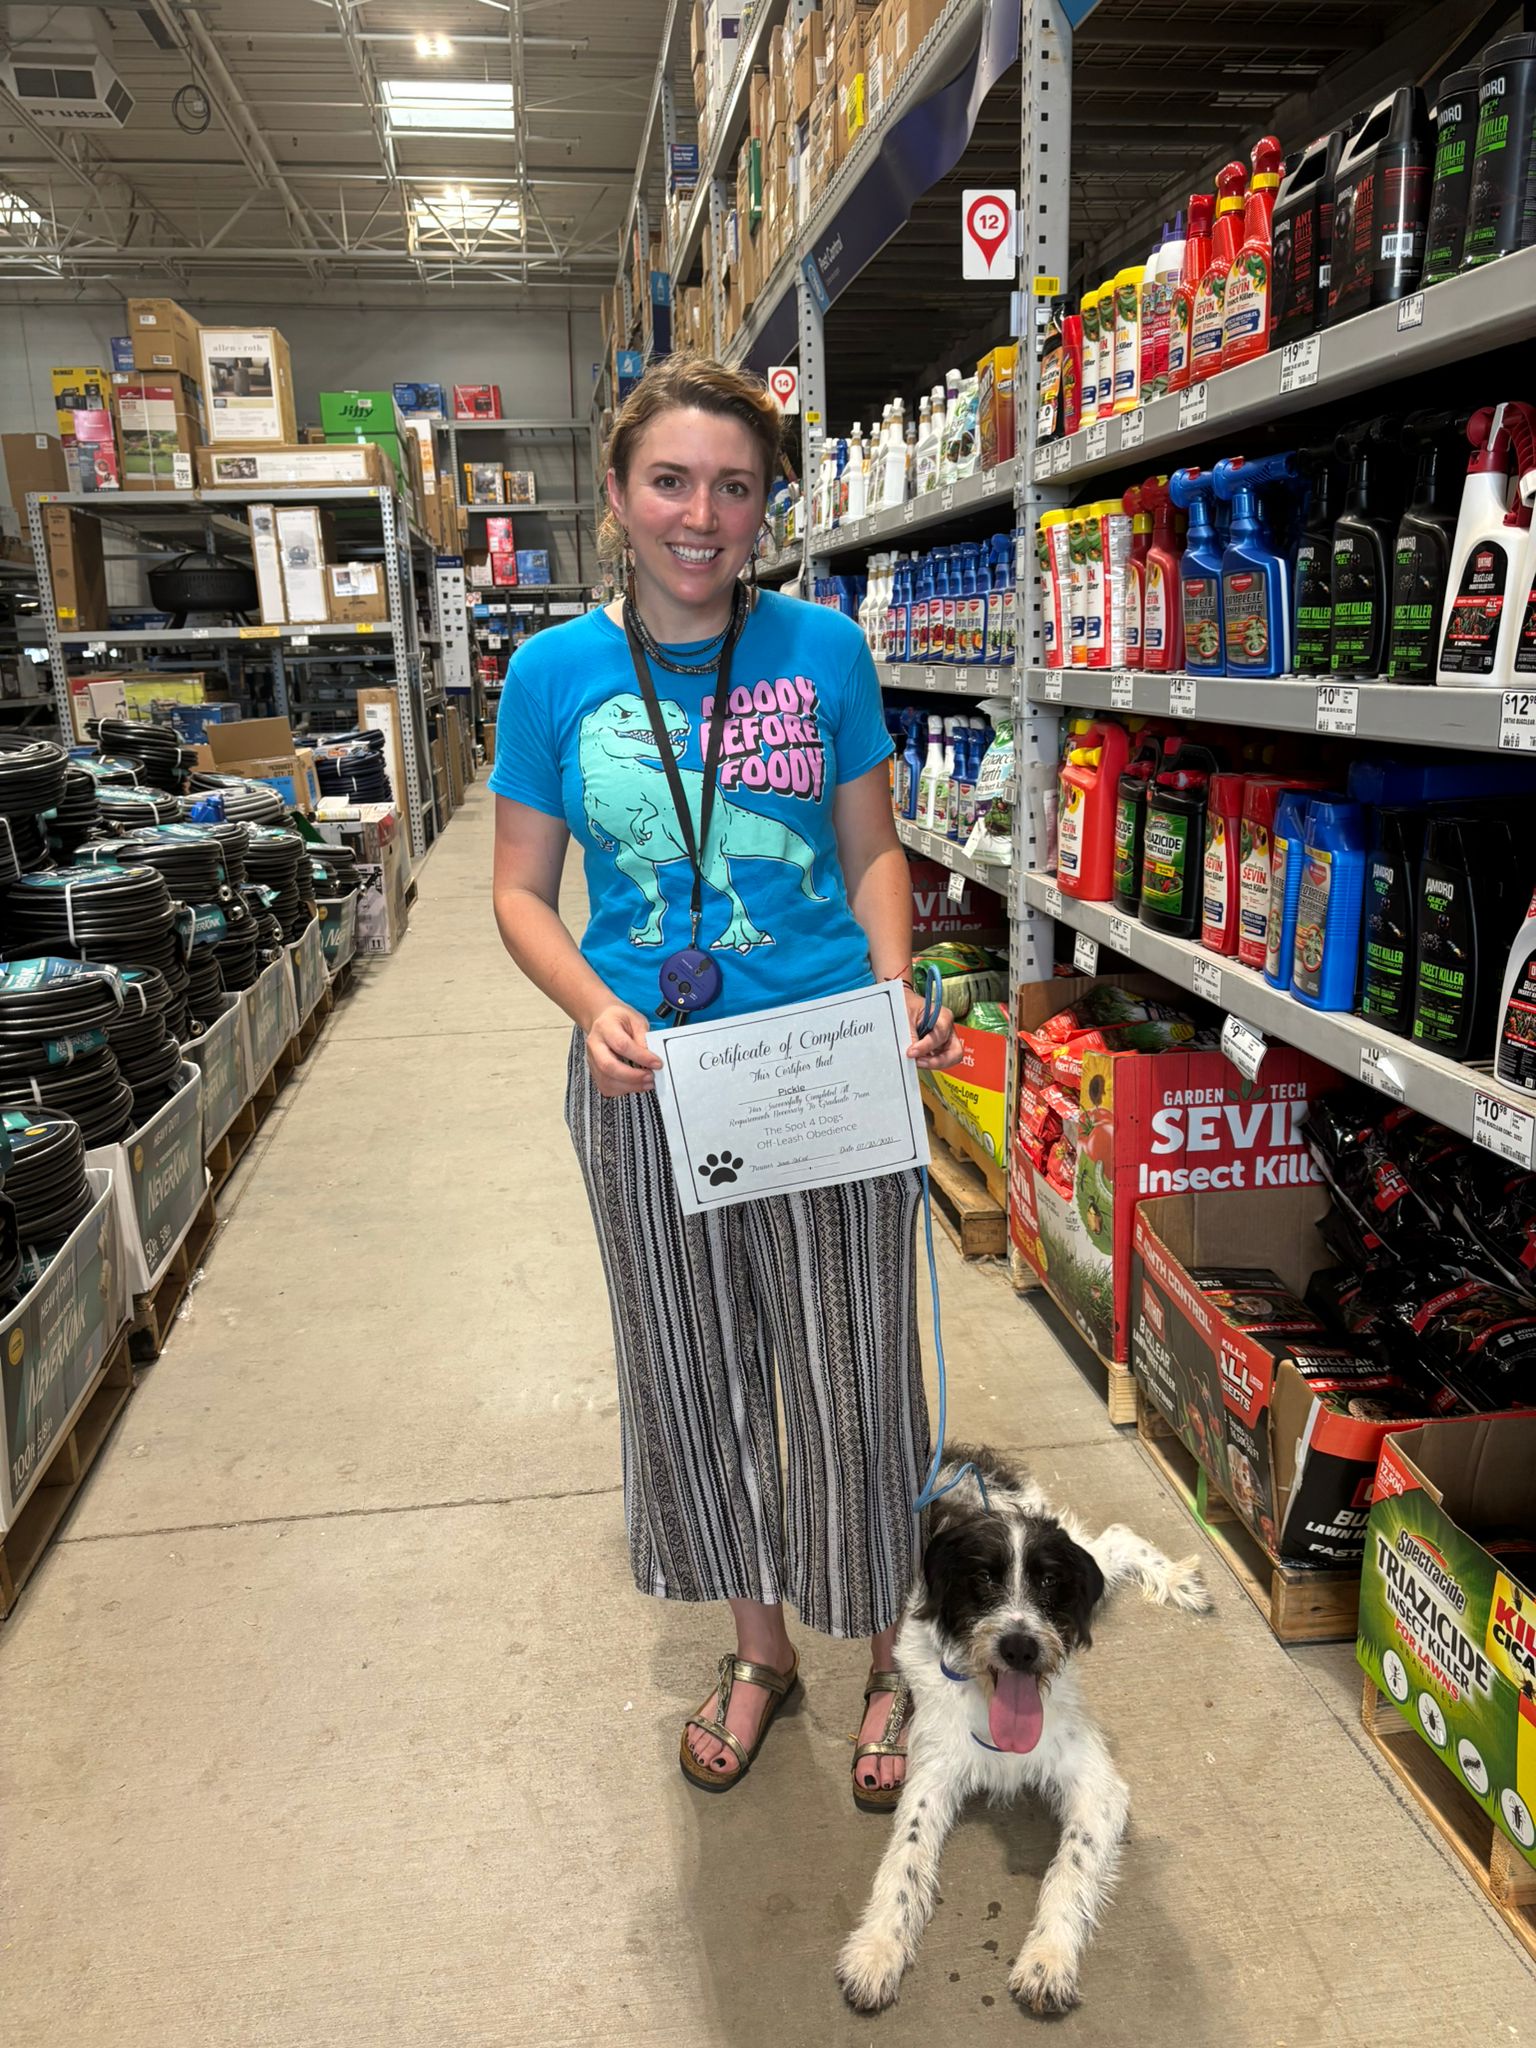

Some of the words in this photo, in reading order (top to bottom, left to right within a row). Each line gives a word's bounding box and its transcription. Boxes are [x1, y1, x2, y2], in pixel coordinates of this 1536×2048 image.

[1479, 77, 1505, 98] MDRO
[1437, 104, 1462, 126] MDRO
[1357, 176, 1374, 194] ANT
[979, 214, 999, 230] 12
[1296, 209, 1312, 228] ANT
[1229, 281, 1250, 298] SEVIN
[1196, 301, 1214, 317] SEVIN
[778, 378, 789, 388] 14
[338, 404, 374, 419] Jiffy
[1312, 607, 1331, 618] KILLER
[1351, 602, 1373, 614] KILLER
[1411, 604, 1432, 618] KILLER
[720, 747, 824, 803] FOODY
[1205, 856, 1222, 873] SEVIN
[1242, 866, 1267, 885] SEVIN
[1425, 877, 1454, 901] AMDRO
[912, 890, 972, 917] VIN
[1427, 894, 1448, 908] QUICK
[1428, 902, 1446, 914] KILL
[1382, 946, 1404, 964] KILLER
[1420, 961, 1439, 979] INSECT
[1439, 965, 1464, 986] KILLER
[699, 1040, 771, 1072] Certificate
[779, 1032, 793, 1060] of
[799, 1019, 875, 1050] Completion
[750, 1070, 770, 1083] This
[775, 1063, 811, 1079] Certifies
[815, 1055, 833, 1069] that
[778, 1084, 805, 1097] Pickle
[1164, 1088, 1223, 1106] GARDEN
[1270, 1083, 1307, 1100] TECH
[764, 1126, 783, 1137] The
[785, 1119, 807, 1134] Spot
[809, 1118, 816, 1126] 4
[819, 1112, 844, 1127] Dogs
[757, 1133, 804, 1150] Off-Leash
[806, 1122, 857, 1140] Obedience
[147, 1145, 190, 1221] NEVERKINK
[1139, 1157, 1244, 1195] Insect
[1254, 1153, 1326, 1186] Kille
[1136, 1223, 1143, 1240] 6
[1167, 1272, 1211, 1333] CONTROL
[1221, 1337, 1248, 1364] KILLS
[1498, 1333, 1515, 1347] 6
[26, 1292, 88, 1423] NEVERKINK
[1296, 1356, 1375, 1368] BUGCLEAR
[1220, 1350, 1254, 1397] ALL
[1297, 1366, 1320, 1376] AWN
[1308, 1377, 1390, 1390] AST-ACTING
[1221, 1379, 1251, 1413] SECTS
[1305, 1520, 1350, 1540] LAWN
[1396, 1528, 1467, 1616] Spectracide
[1377, 1536, 1489, 1693] TRIAZICIDE
[1495, 1595, 1536, 1654] KIL
[1386, 1583, 1427, 1642] INSECT
[1427, 1631, 1472, 1696] KILLER
[1492, 1621, 1536, 1679] CICA
[1394, 1617, 1417, 1653] FOR
[1417, 1645, 1461, 1703] LAWNS
